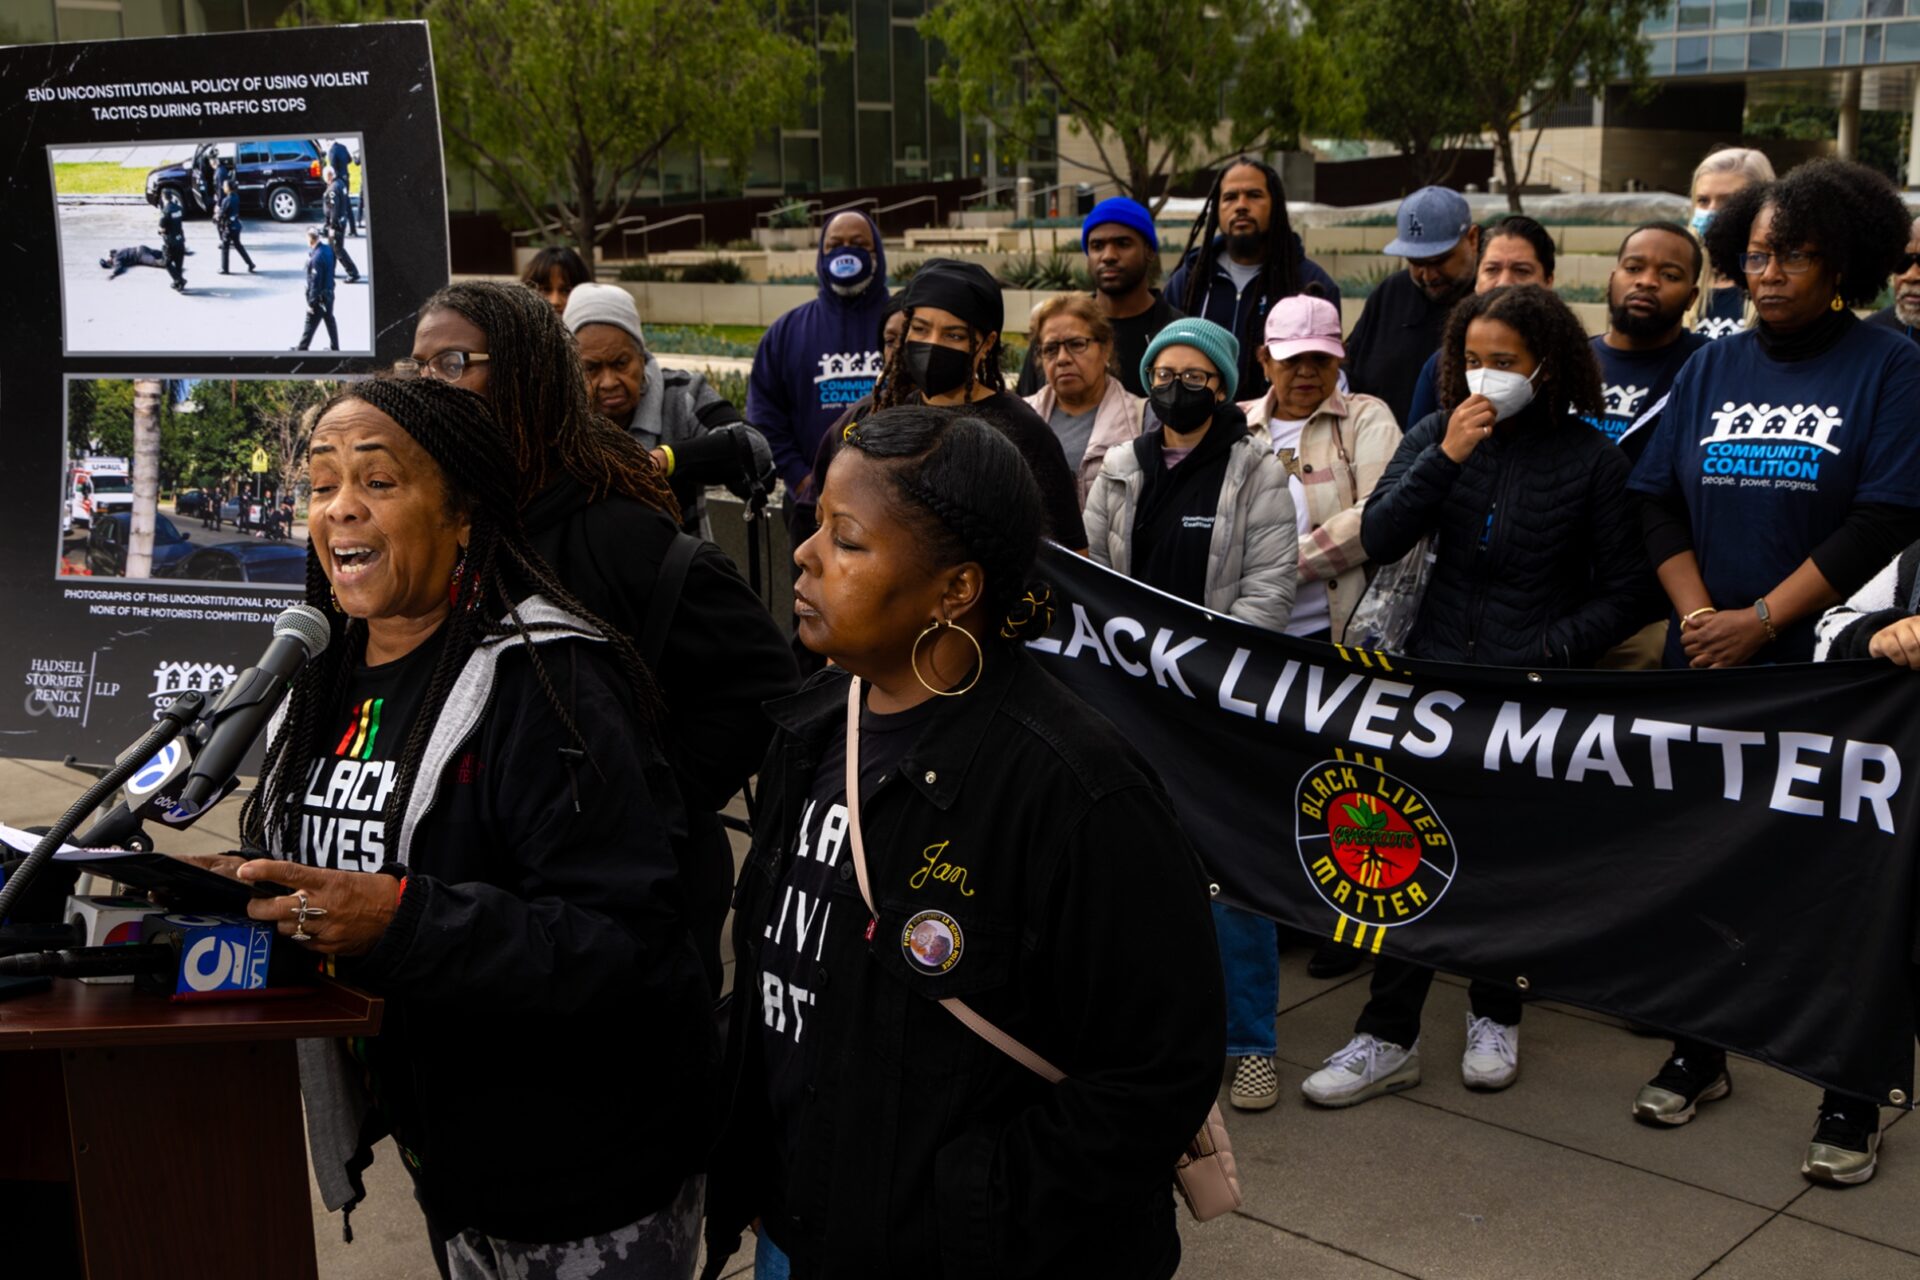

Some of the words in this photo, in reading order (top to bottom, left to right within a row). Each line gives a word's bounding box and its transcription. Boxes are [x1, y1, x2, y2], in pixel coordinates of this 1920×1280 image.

[28, 88, 55, 102] END
[57, 81, 189, 100] UNCONSTITUTIONAL
[191, 78, 239, 94] POLICY
[243, 76, 262, 91] OF
[264, 74, 308, 90] USING
[310, 71, 369, 88] VIOLENT
[92, 105, 148, 120] TACTICS
[150, 102, 201, 118] DURING
[203, 100, 259, 115] TRAFFIC
[261, 97, 306, 113] STOPS
[1408, 211, 1424, 237] LA
[819, 380, 876, 391] COMMUN
[820, 390, 870, 402] COALI
[1706, 442, 1823, 461] COMMUNITY
[1702, 457, 1820, 480] COALITION
[1702, 475, 1736, 487] people.
[1740, 478, 1771, 488] power.
[1774, 479, 1818, 491] progress.
[64, 589, 132, 601] PHOTOGRAPHS
[133, 592, 147, 602] OF
[148, 593, 168, 603] THIS
[169, 594, 262, 607] UNCONSTITUTIONAL
[89, 605, 116, 615] NONE
[117, 606, 131, 616] OF
[131, 607, 150, 617] THE
[151, 608, 203, 619] MOTORISTS
[204, 610, 260, 622] COMMITTED
[31, 659, 86, 674] HADSELL
[25, 673, 83, 688] STORMER
[95, 682, 120, 697] LLP
[34, 688, 82, 703] RENICK
[57, 705, 80, 718] DAI
[1218, 648, 1465, 759] LIVES
[1483, 700, 1902, 835] MATTER
[286, 757, 399, 812] LACK
[154, 795, 178, 809] abc
[1302, 767, 1358, 820] BLACK
[1377, 776, 1447, 847] LIVES
[286, 813, 385, 874] IVES
[1333, 826, 1416, 849] GRASSROOTS
[909, 839, 975, 897] Jan
[1312, 855, 1428, 918] MATTER
[941, 916, 950, 926] LA
[949, 923, 961, 948] SCHOOL
[248, 931, 270, 989] KTLA
[941, 949, 960, 971] POLICE
